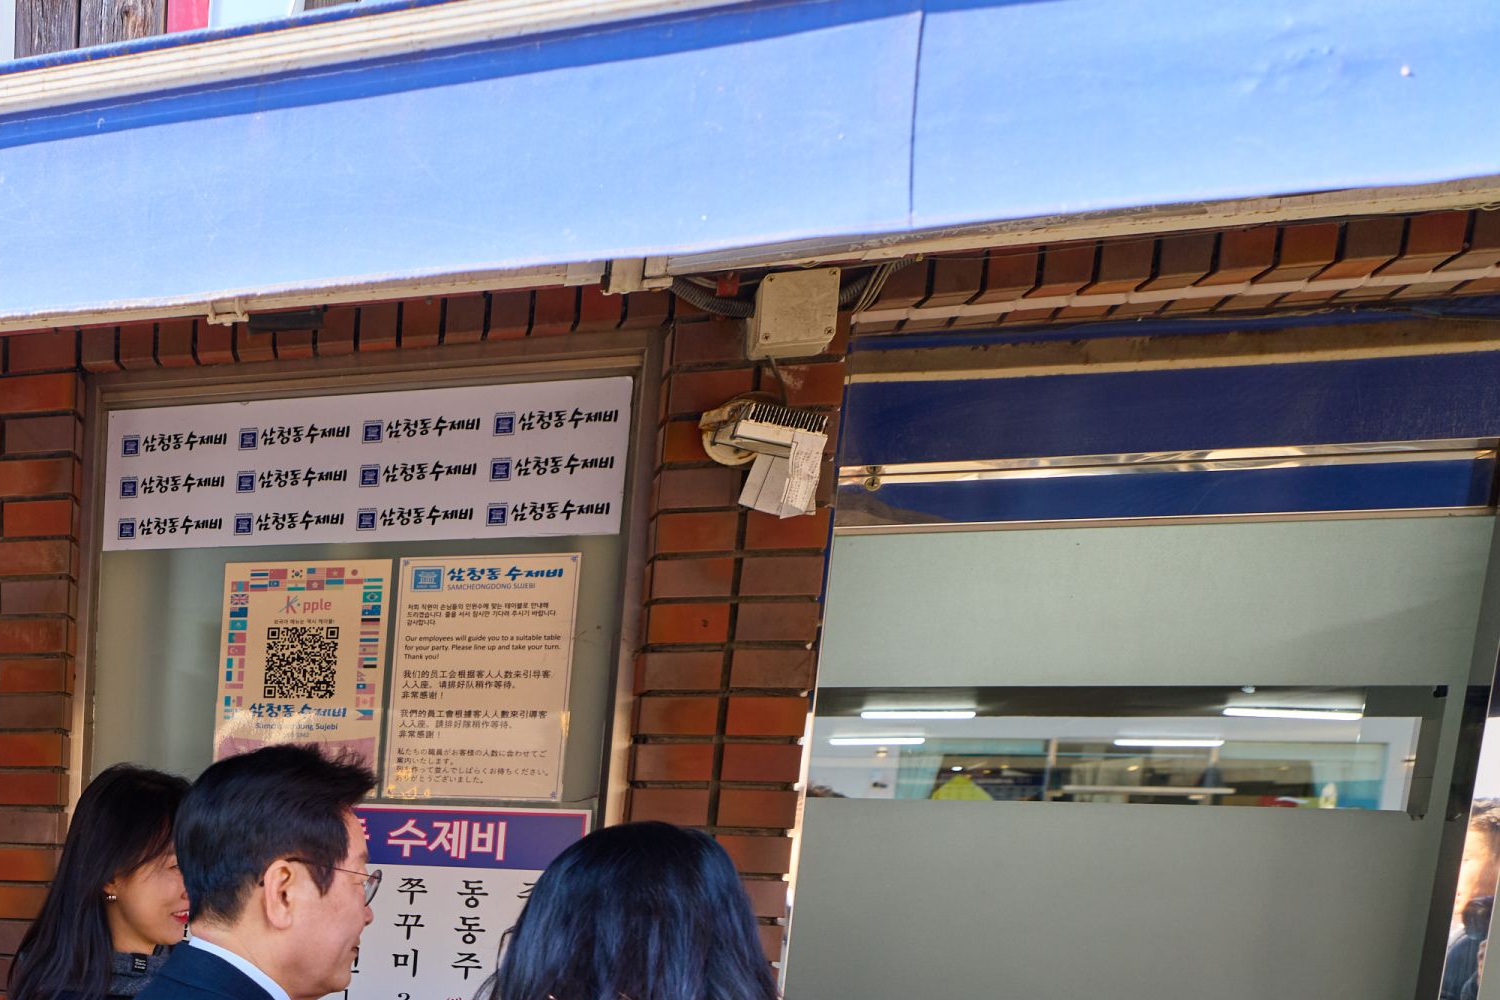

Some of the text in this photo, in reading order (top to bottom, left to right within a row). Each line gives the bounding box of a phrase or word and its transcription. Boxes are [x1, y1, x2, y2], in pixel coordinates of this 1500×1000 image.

[447, 566, 564, 581] 삼청동 수제비
[419, 635, 453, 643] employees
[468, 635, 486, 643] guide
[387, 817, 507, 861] 수제비
[392, 877, 428, 978] 쭈꾸미
[451, 880, 489, 980] 동동주
